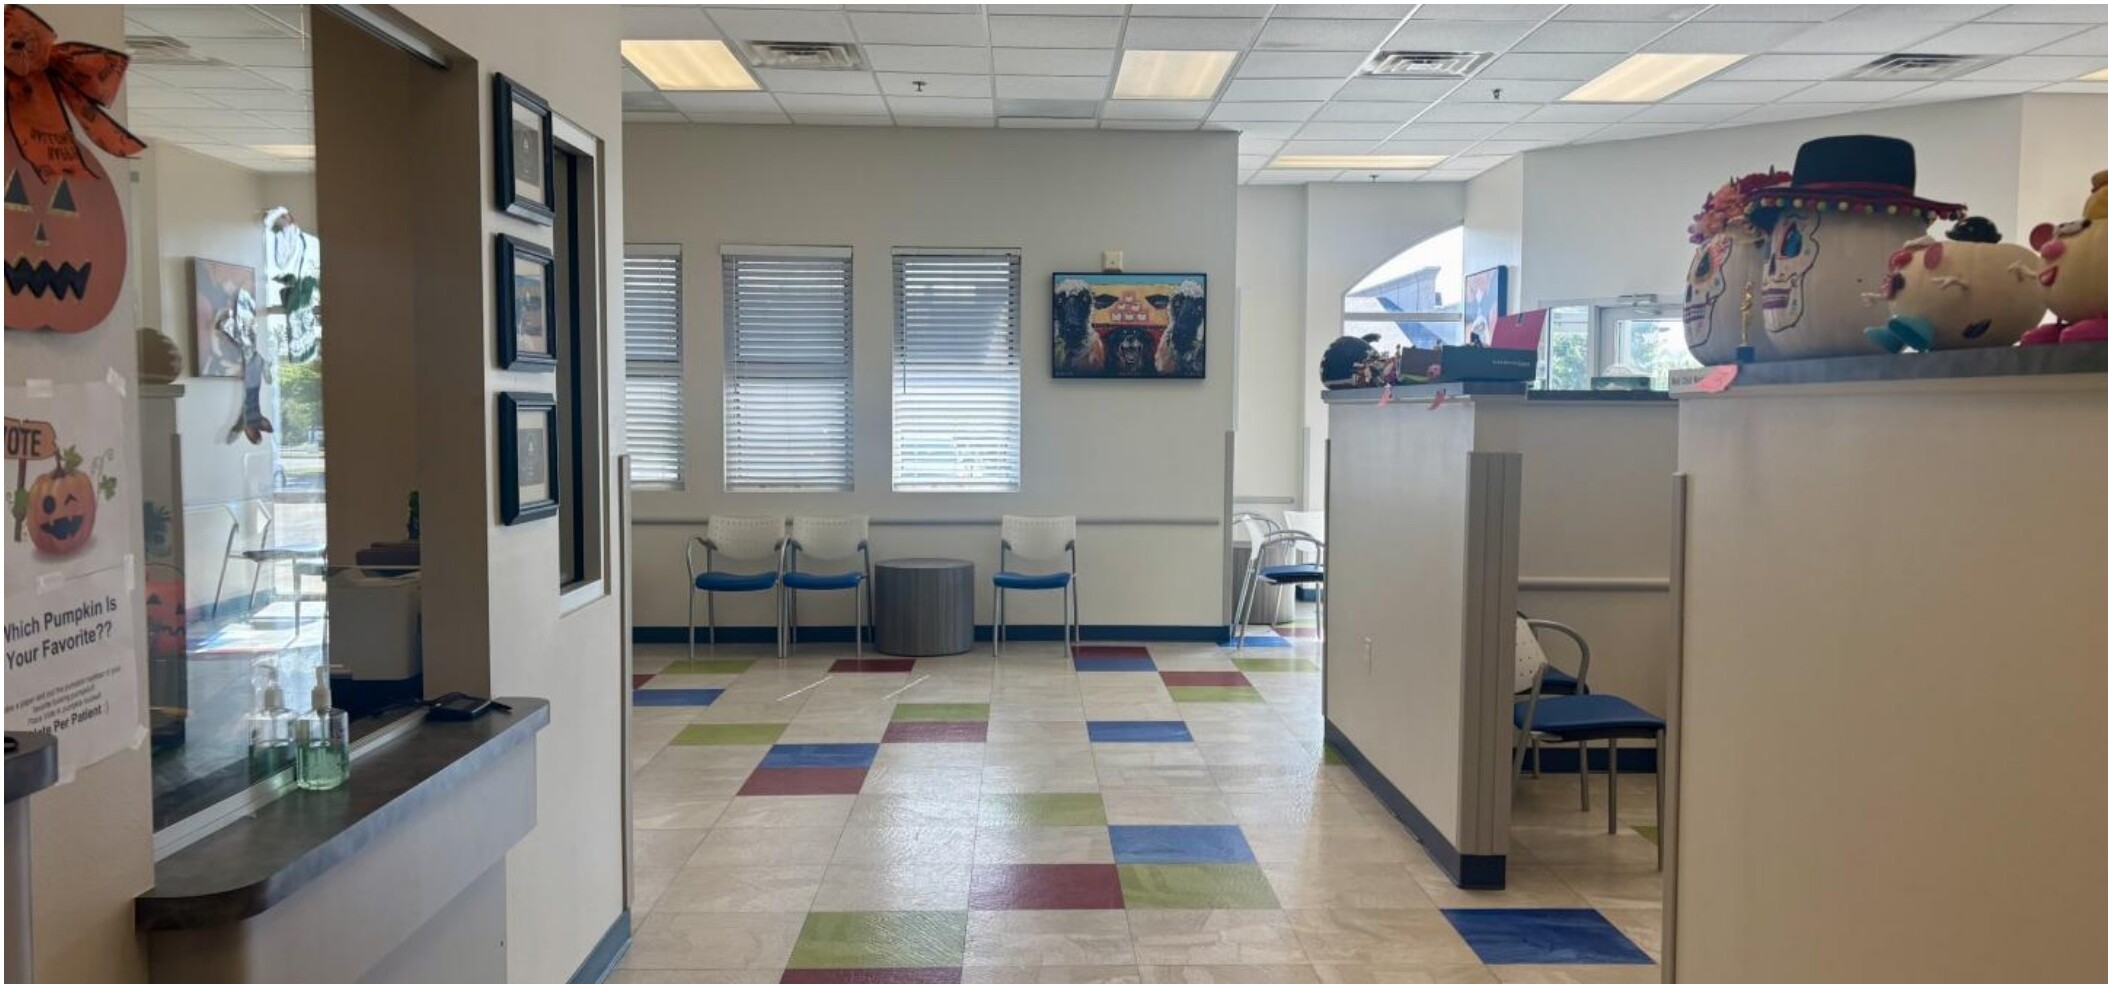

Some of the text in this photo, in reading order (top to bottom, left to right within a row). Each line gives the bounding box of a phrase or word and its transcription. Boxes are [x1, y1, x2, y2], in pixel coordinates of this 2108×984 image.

[4, 423, 41, 456] OTE
[44, 600, 103, 630] Pumpkin
[106, 595, 117, 612] Is
[6, 621, 112, 670] Your Favorite??
[53, 717, 70, 733] Per
[71, 704, 102, 726] Patient
